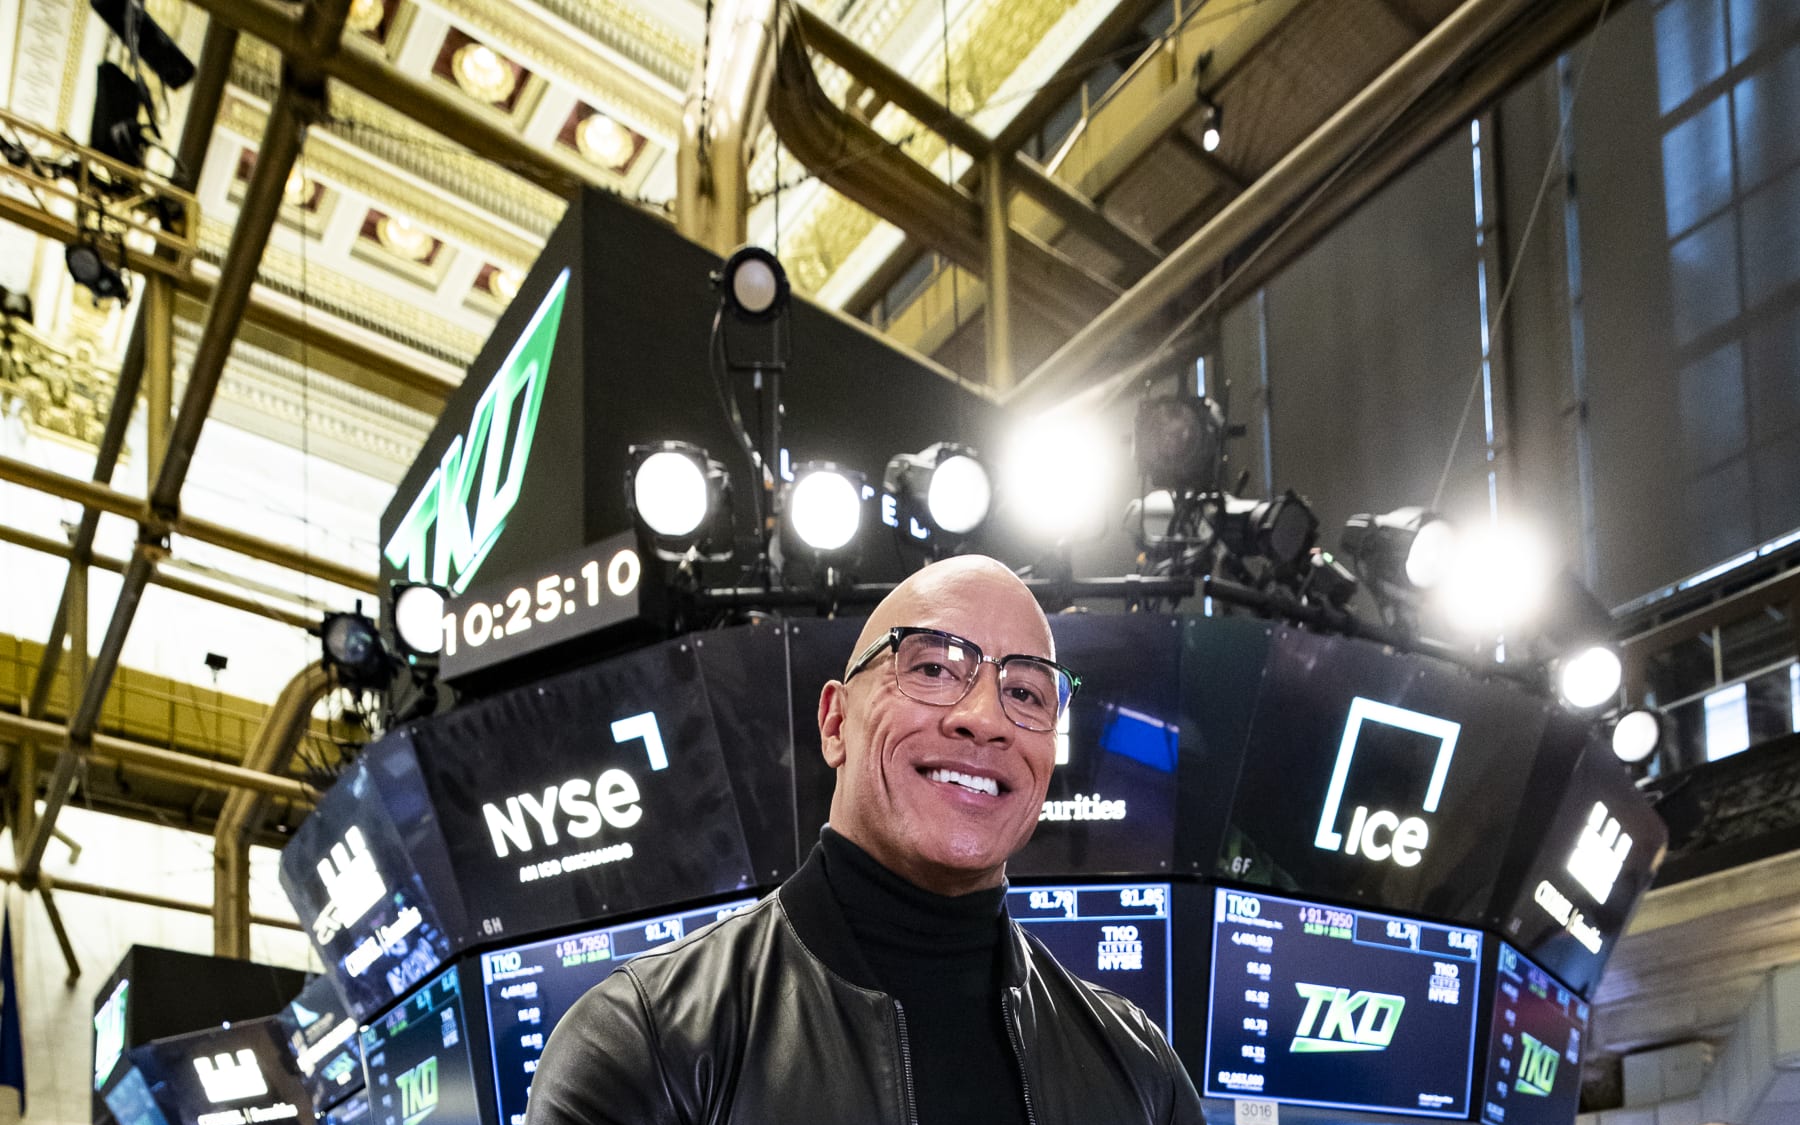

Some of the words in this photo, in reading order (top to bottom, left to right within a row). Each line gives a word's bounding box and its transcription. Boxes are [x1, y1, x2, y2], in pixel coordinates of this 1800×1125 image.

[384, 267, 570, 594] TKO
[441, 549, 641, 656] 10:25:10
[1038, 793, 1126, 821] curities
[1227, 894, 1261, 917] TKO
[483, 917, 503, 936] 6H
[1101, 926, 1139, 942] TKO
[491, 951, 521, 973] TKO
[1291, 982, 1406, 1050] TKO
[1516, 1032, 1560, 1096] TKO
[1241, 1103, 1272, 1118] 3016
